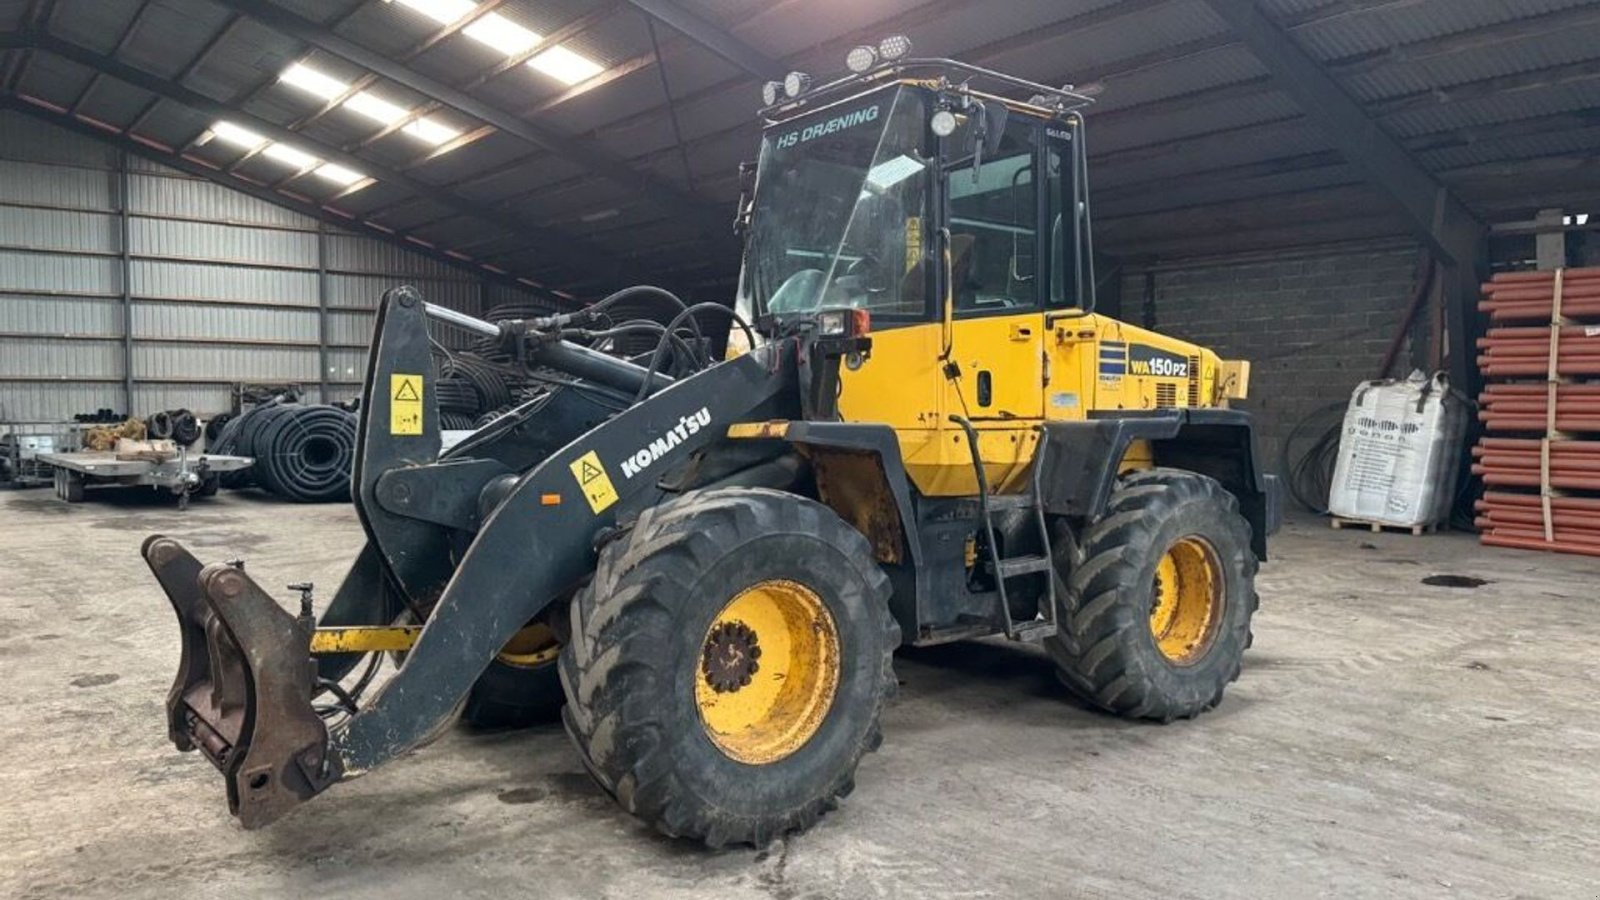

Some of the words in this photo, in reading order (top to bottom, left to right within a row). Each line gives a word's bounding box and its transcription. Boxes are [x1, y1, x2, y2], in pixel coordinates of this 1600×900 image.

[776, 131, 799, 150] HS
[801, 105, 879, 142] DRÆNING
[1130, 357, 1187, 376] WA150PZ
[620, 406, 711, 479] KOMATSU
